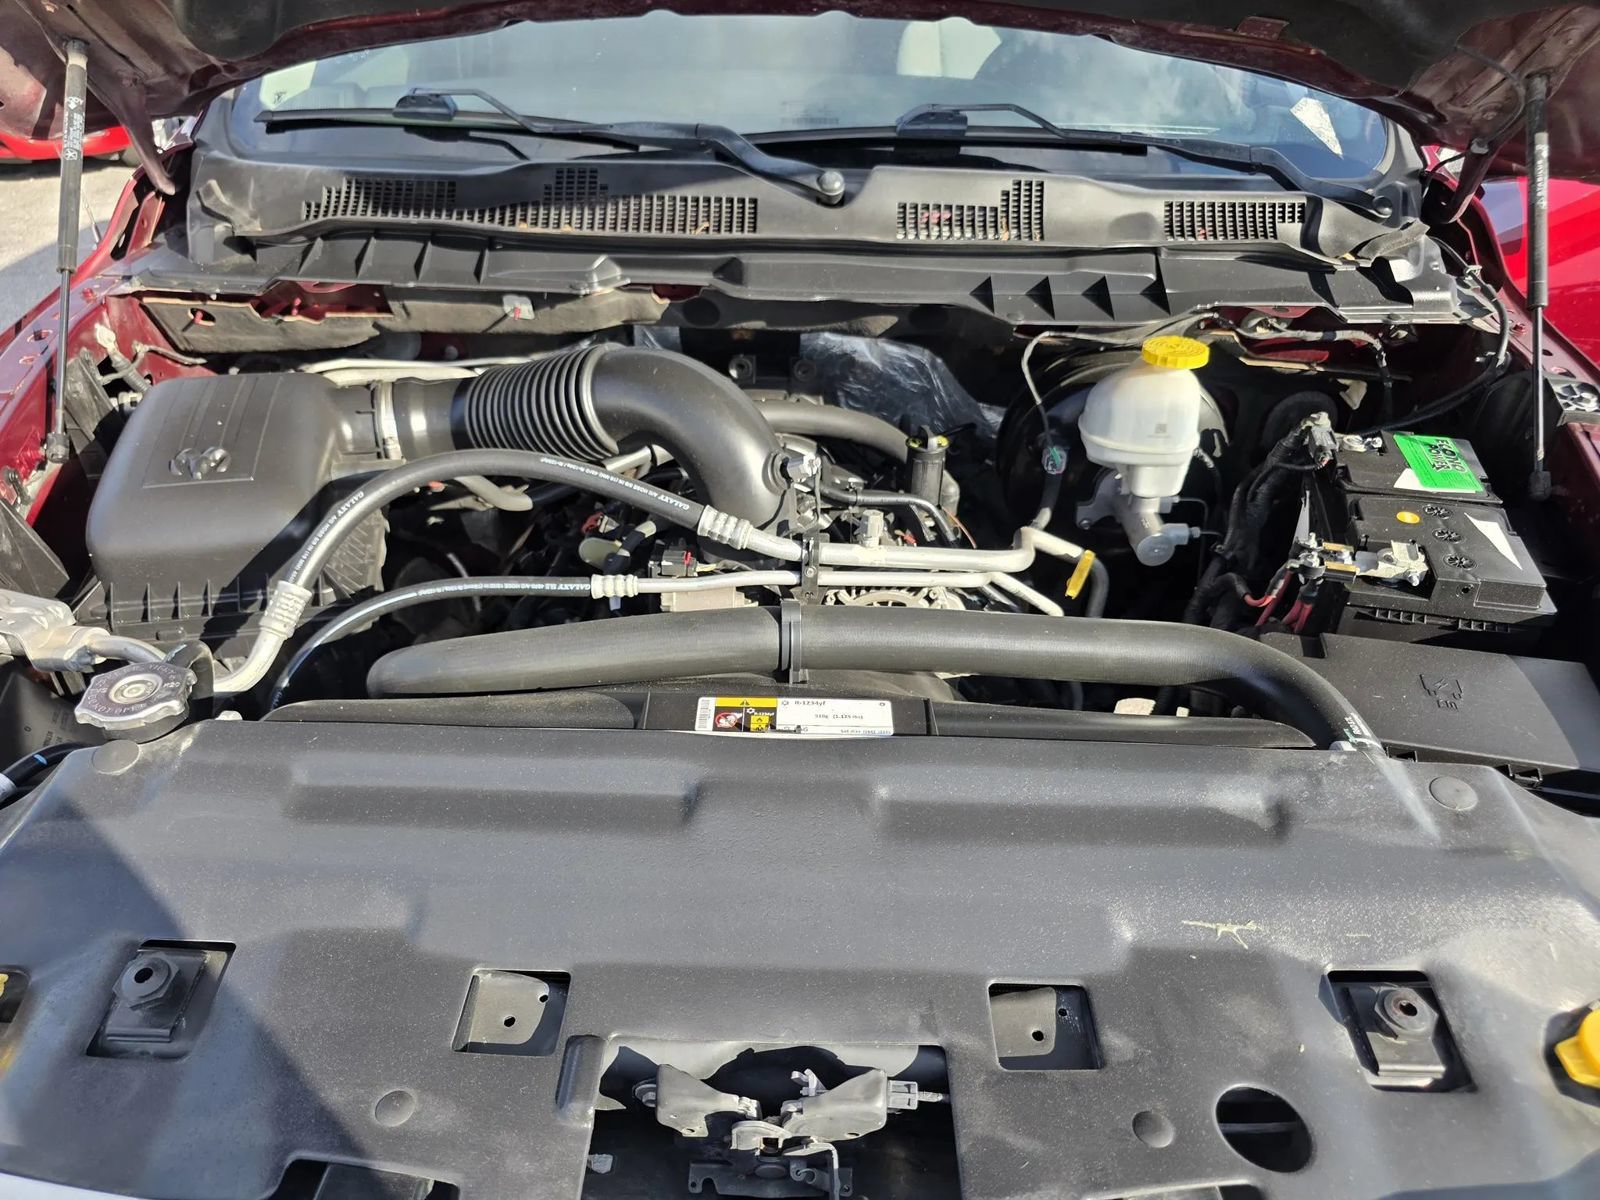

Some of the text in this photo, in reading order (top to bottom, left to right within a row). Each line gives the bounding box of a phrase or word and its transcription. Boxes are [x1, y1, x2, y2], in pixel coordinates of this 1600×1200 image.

[1428, 443, 1451, 471] POWER
[1436, 439, 1466, 473] ECONO
[337, 491, 364, 518] GALAXY
[657, 495, 690, 511] GALAXY
[557, 582, 590, 590] GALAXY
